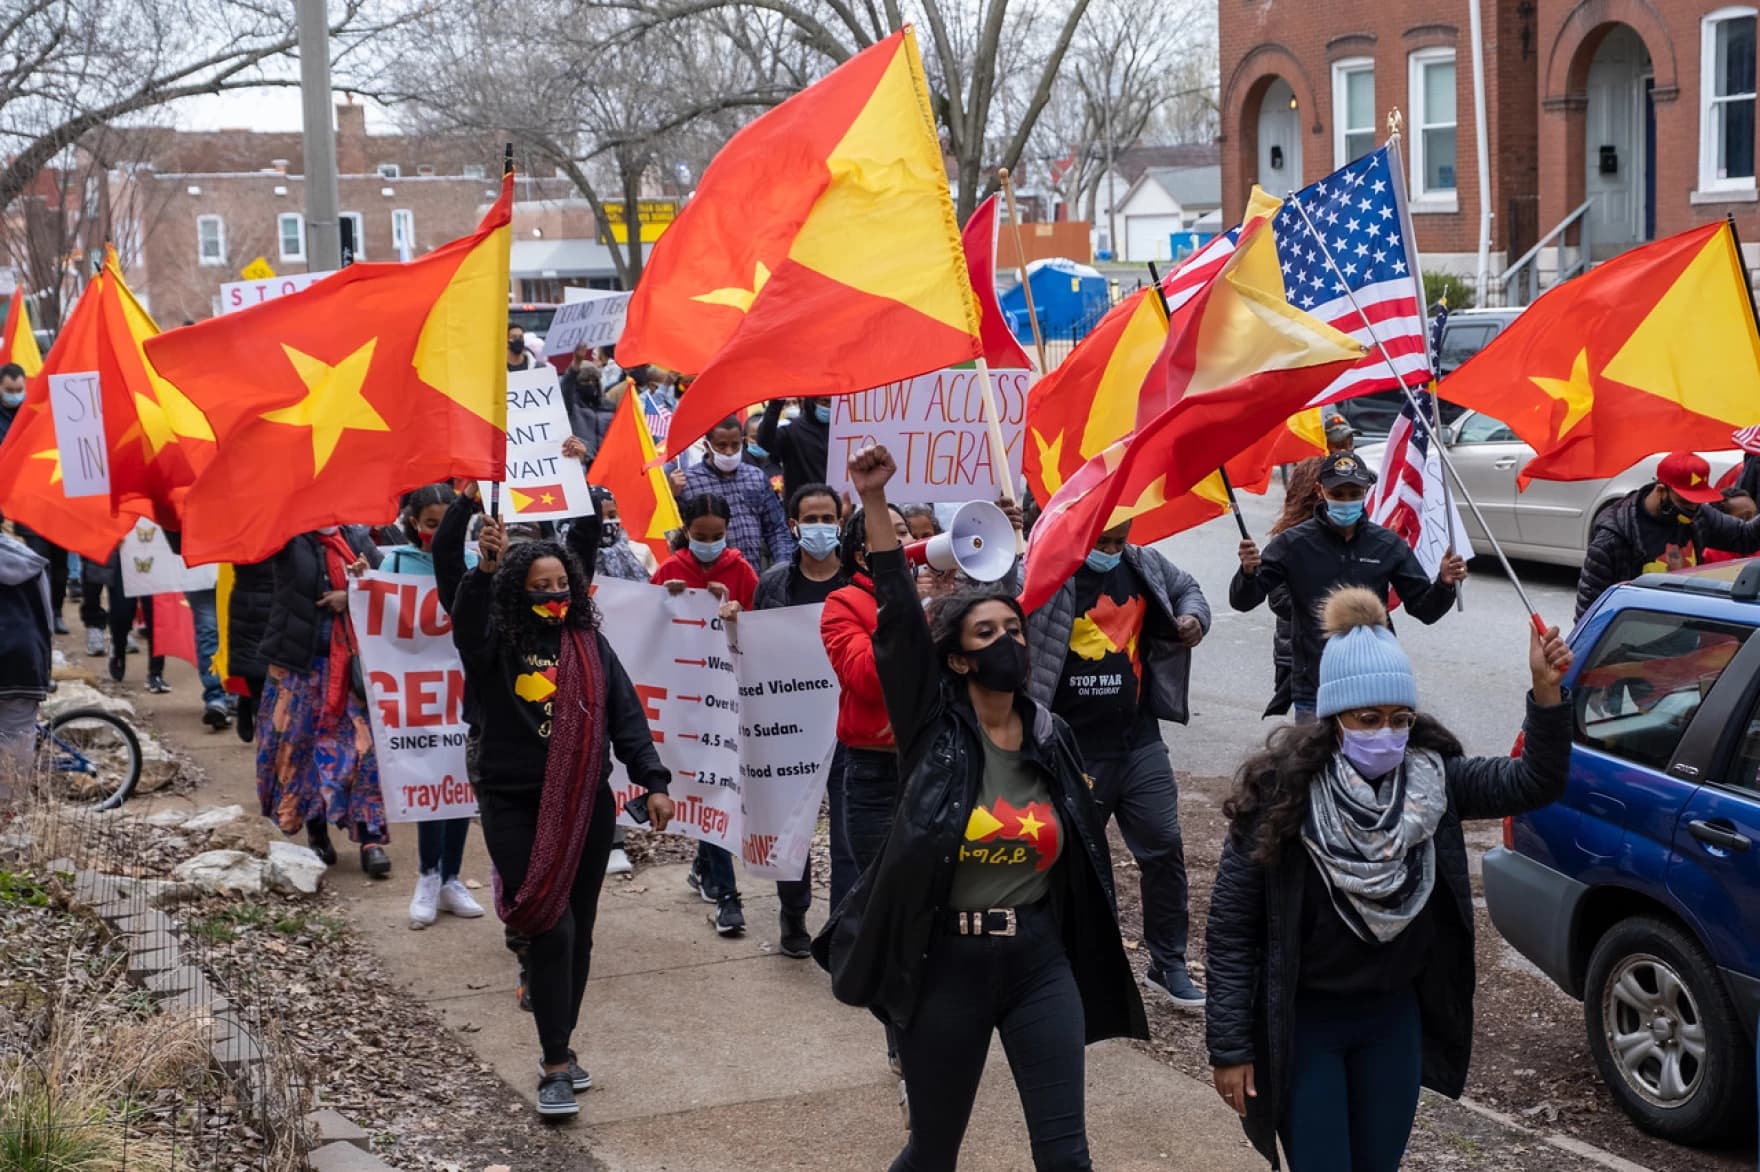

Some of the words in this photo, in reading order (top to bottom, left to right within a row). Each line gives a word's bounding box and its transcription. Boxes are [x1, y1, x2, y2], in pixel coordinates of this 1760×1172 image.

[230, 280, 318, 306] STO
[64, 377, 103, 422] ST
[835, 378, 914, 425] ALLOW
[768, 678, 834, 695] Violence.
[1069, 675, 1097, 687] STOP
[1099, 673, 1122, 687] WAR
[1078, 687, 1090, 696] ON
[705, 694, 728, 710] Over
[753, 721, 804, 738] Sudan.
[390, 734, 438, 751] SINCE
[701, 733, 721, 747] 4.5
[698, 771, 716, 785] 2.3
[402, 774, 476, 814] rayGen
